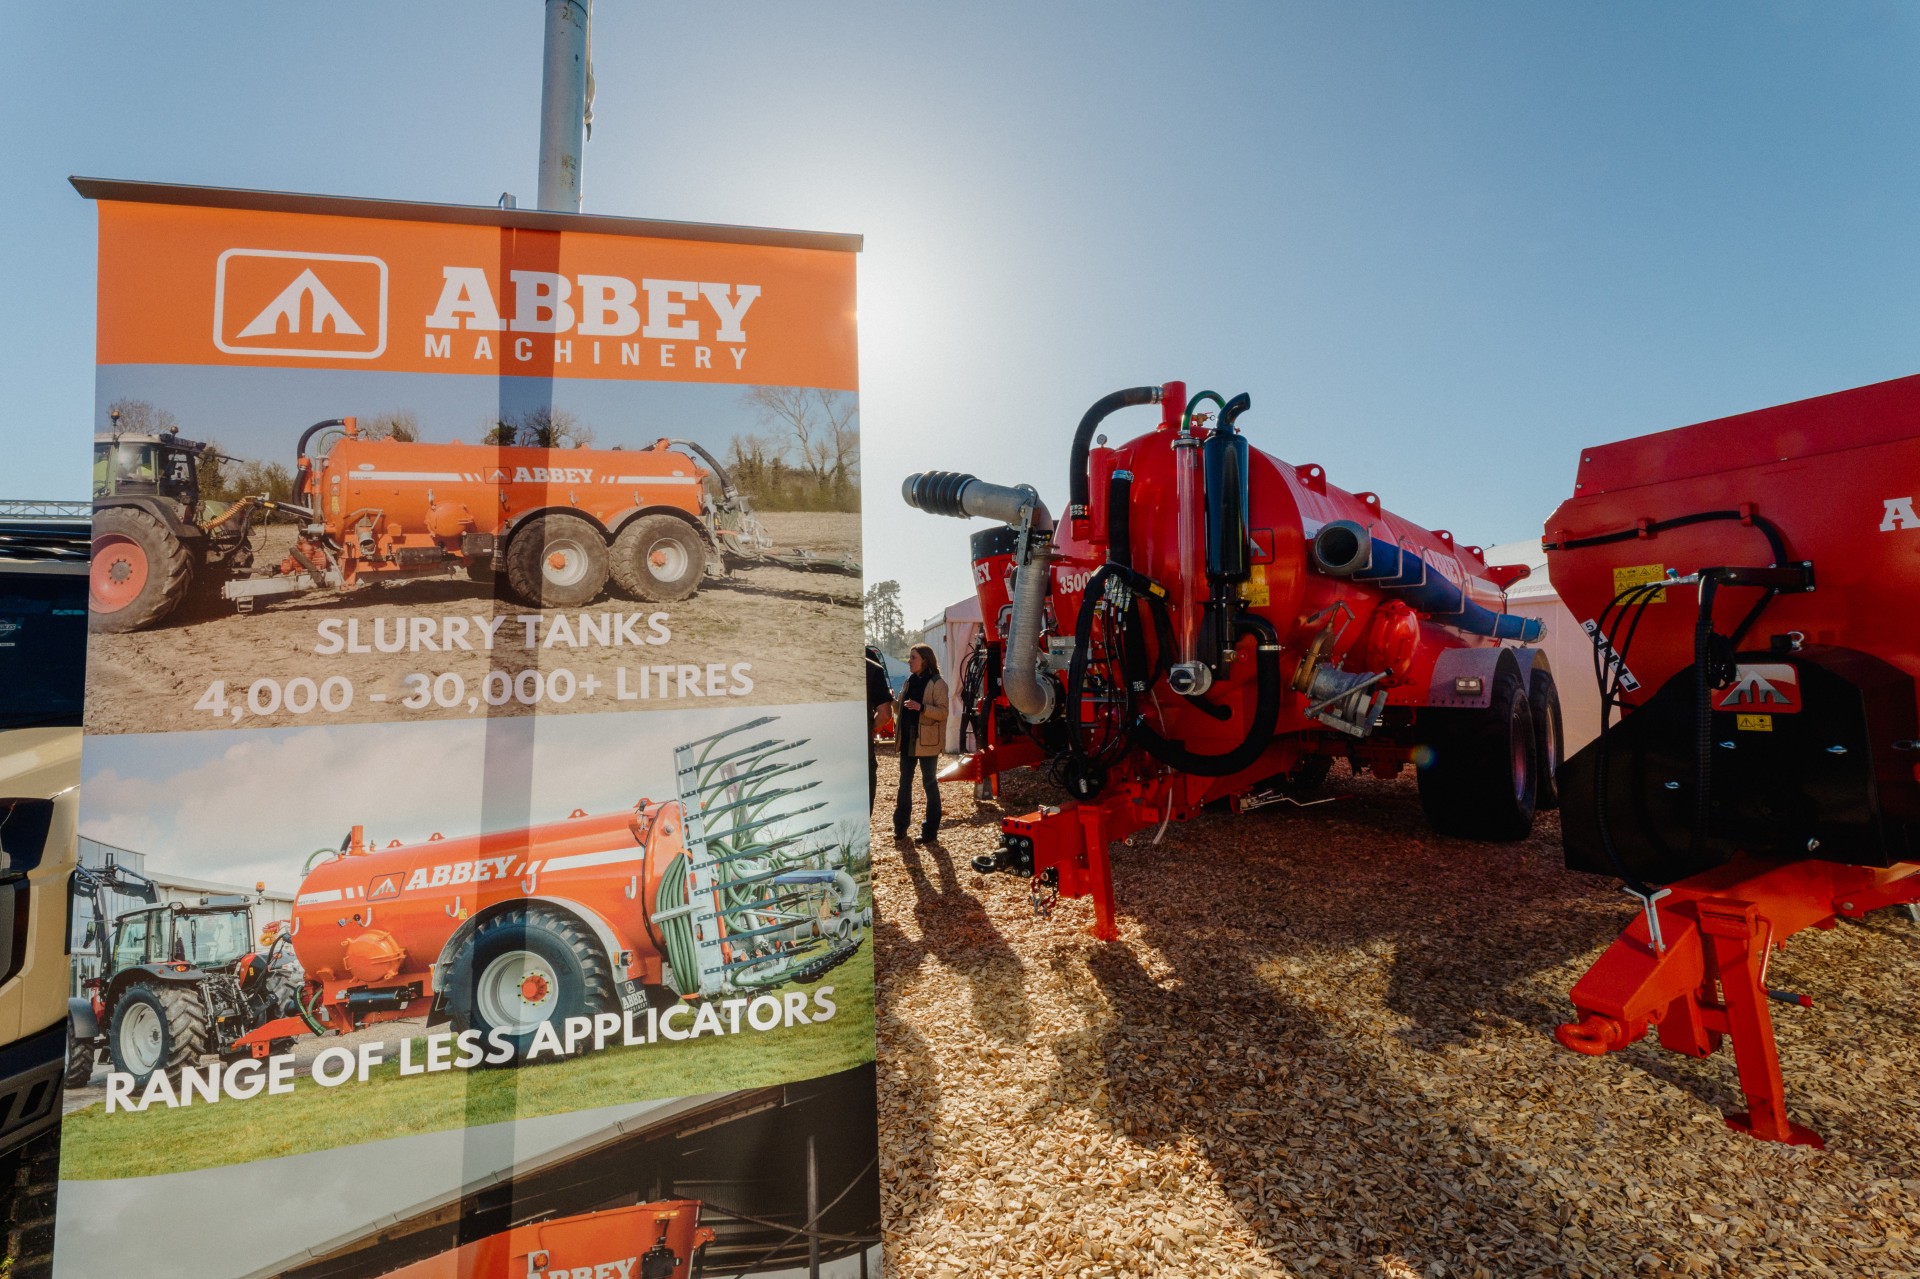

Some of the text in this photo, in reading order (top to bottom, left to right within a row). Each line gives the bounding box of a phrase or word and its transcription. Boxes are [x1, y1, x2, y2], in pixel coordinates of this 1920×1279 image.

[425, 266, 761, 343] ABBEY
[424, 334, 747, 370] MACHINERY
[513, 466, 593, 484] ABBEY
[314, 612, 672, 655] SLURRY TANKS
[193, 675, 353, 724] 4,000
[402, 668, 602, 714] 30,000+
[616, 662, 754, 700] LITRES
[405, 855, 518, 891] ABBEY
[621, 990, 647, 1010] ABBEY
[105, 986, 837, 1113] RANGE OF LESS APPLICATORS
